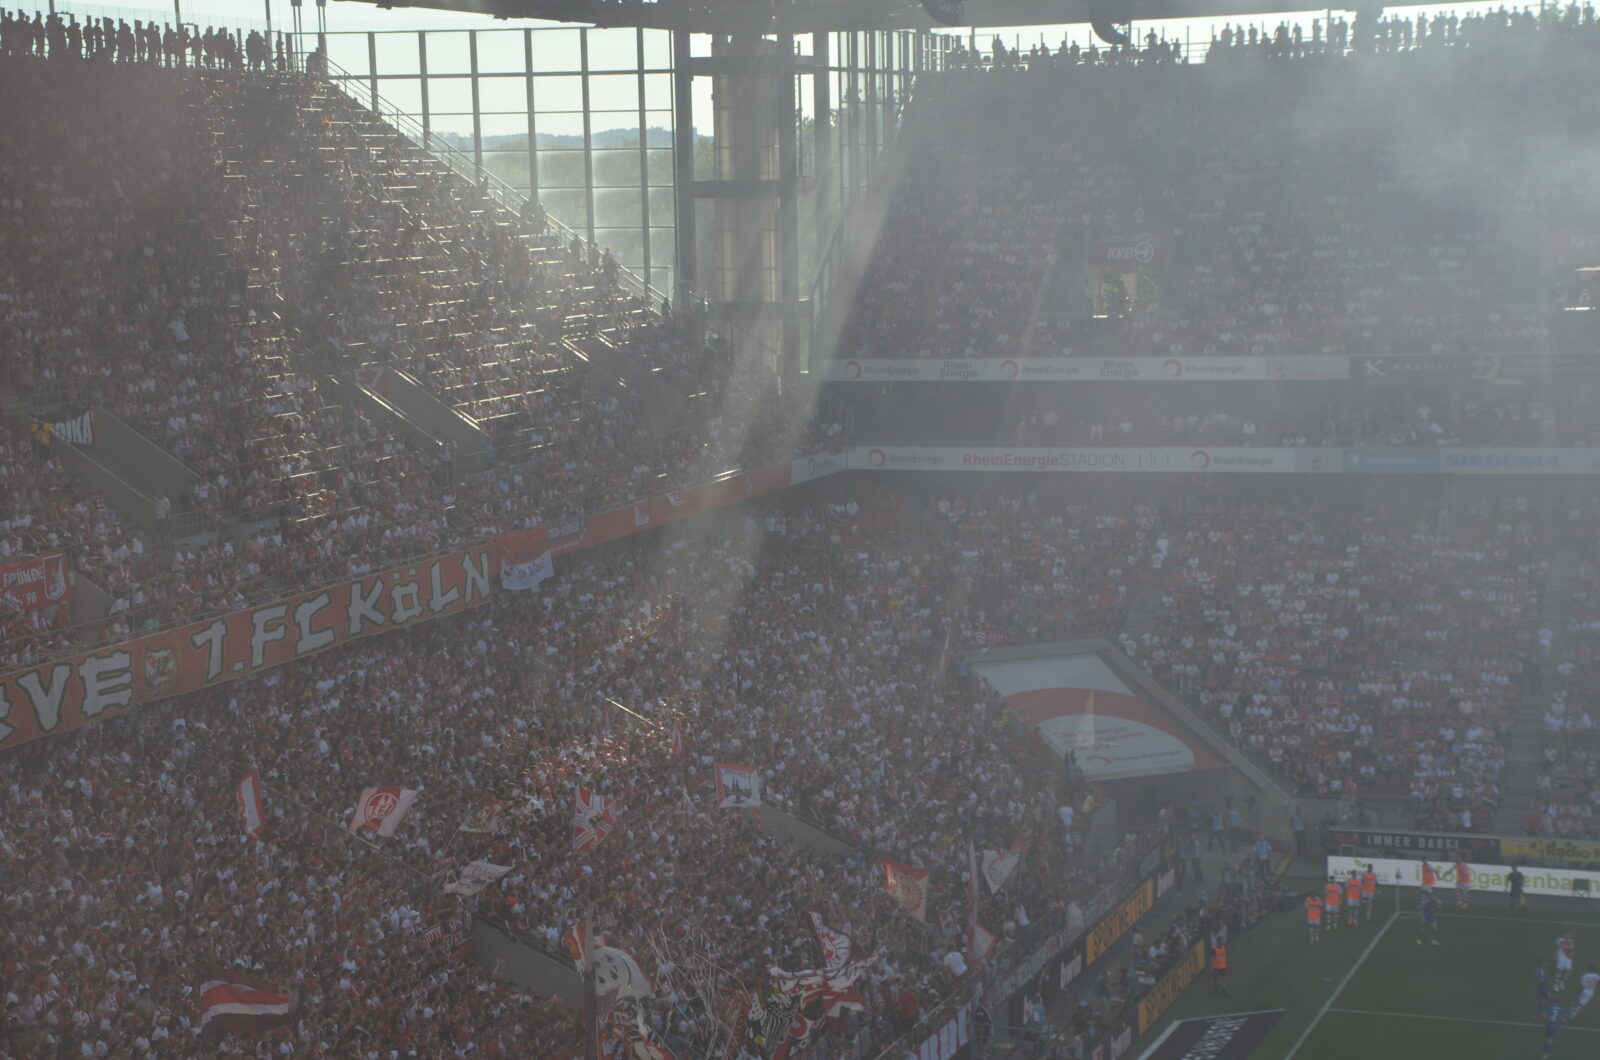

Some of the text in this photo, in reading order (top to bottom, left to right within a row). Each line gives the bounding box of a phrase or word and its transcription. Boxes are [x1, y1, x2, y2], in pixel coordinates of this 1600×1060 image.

[1107, 247, 1134, 260] KVB
[943, 360, 972, 370] Rhein
[1103, 359, 1133, 369] Rhein
[865, 366, 920, 377] RheinEnergie
[940, 369, 979, 380] Energie
[1022, 365, 1079, 377] RheinEnergie
[1100, 368, 1140, 379] Energie
[889, 455, 944, 466] RheinEnergie
[1213, 456, 1274, 467] RheinEnergie
[1446, 455, 1560, 467] SIEGENIA
[346, 551, 490, 635] KÖLN
[1367, 835, 1411, 848] IMMER
[1418, 837, 1459, 849] DABEI
